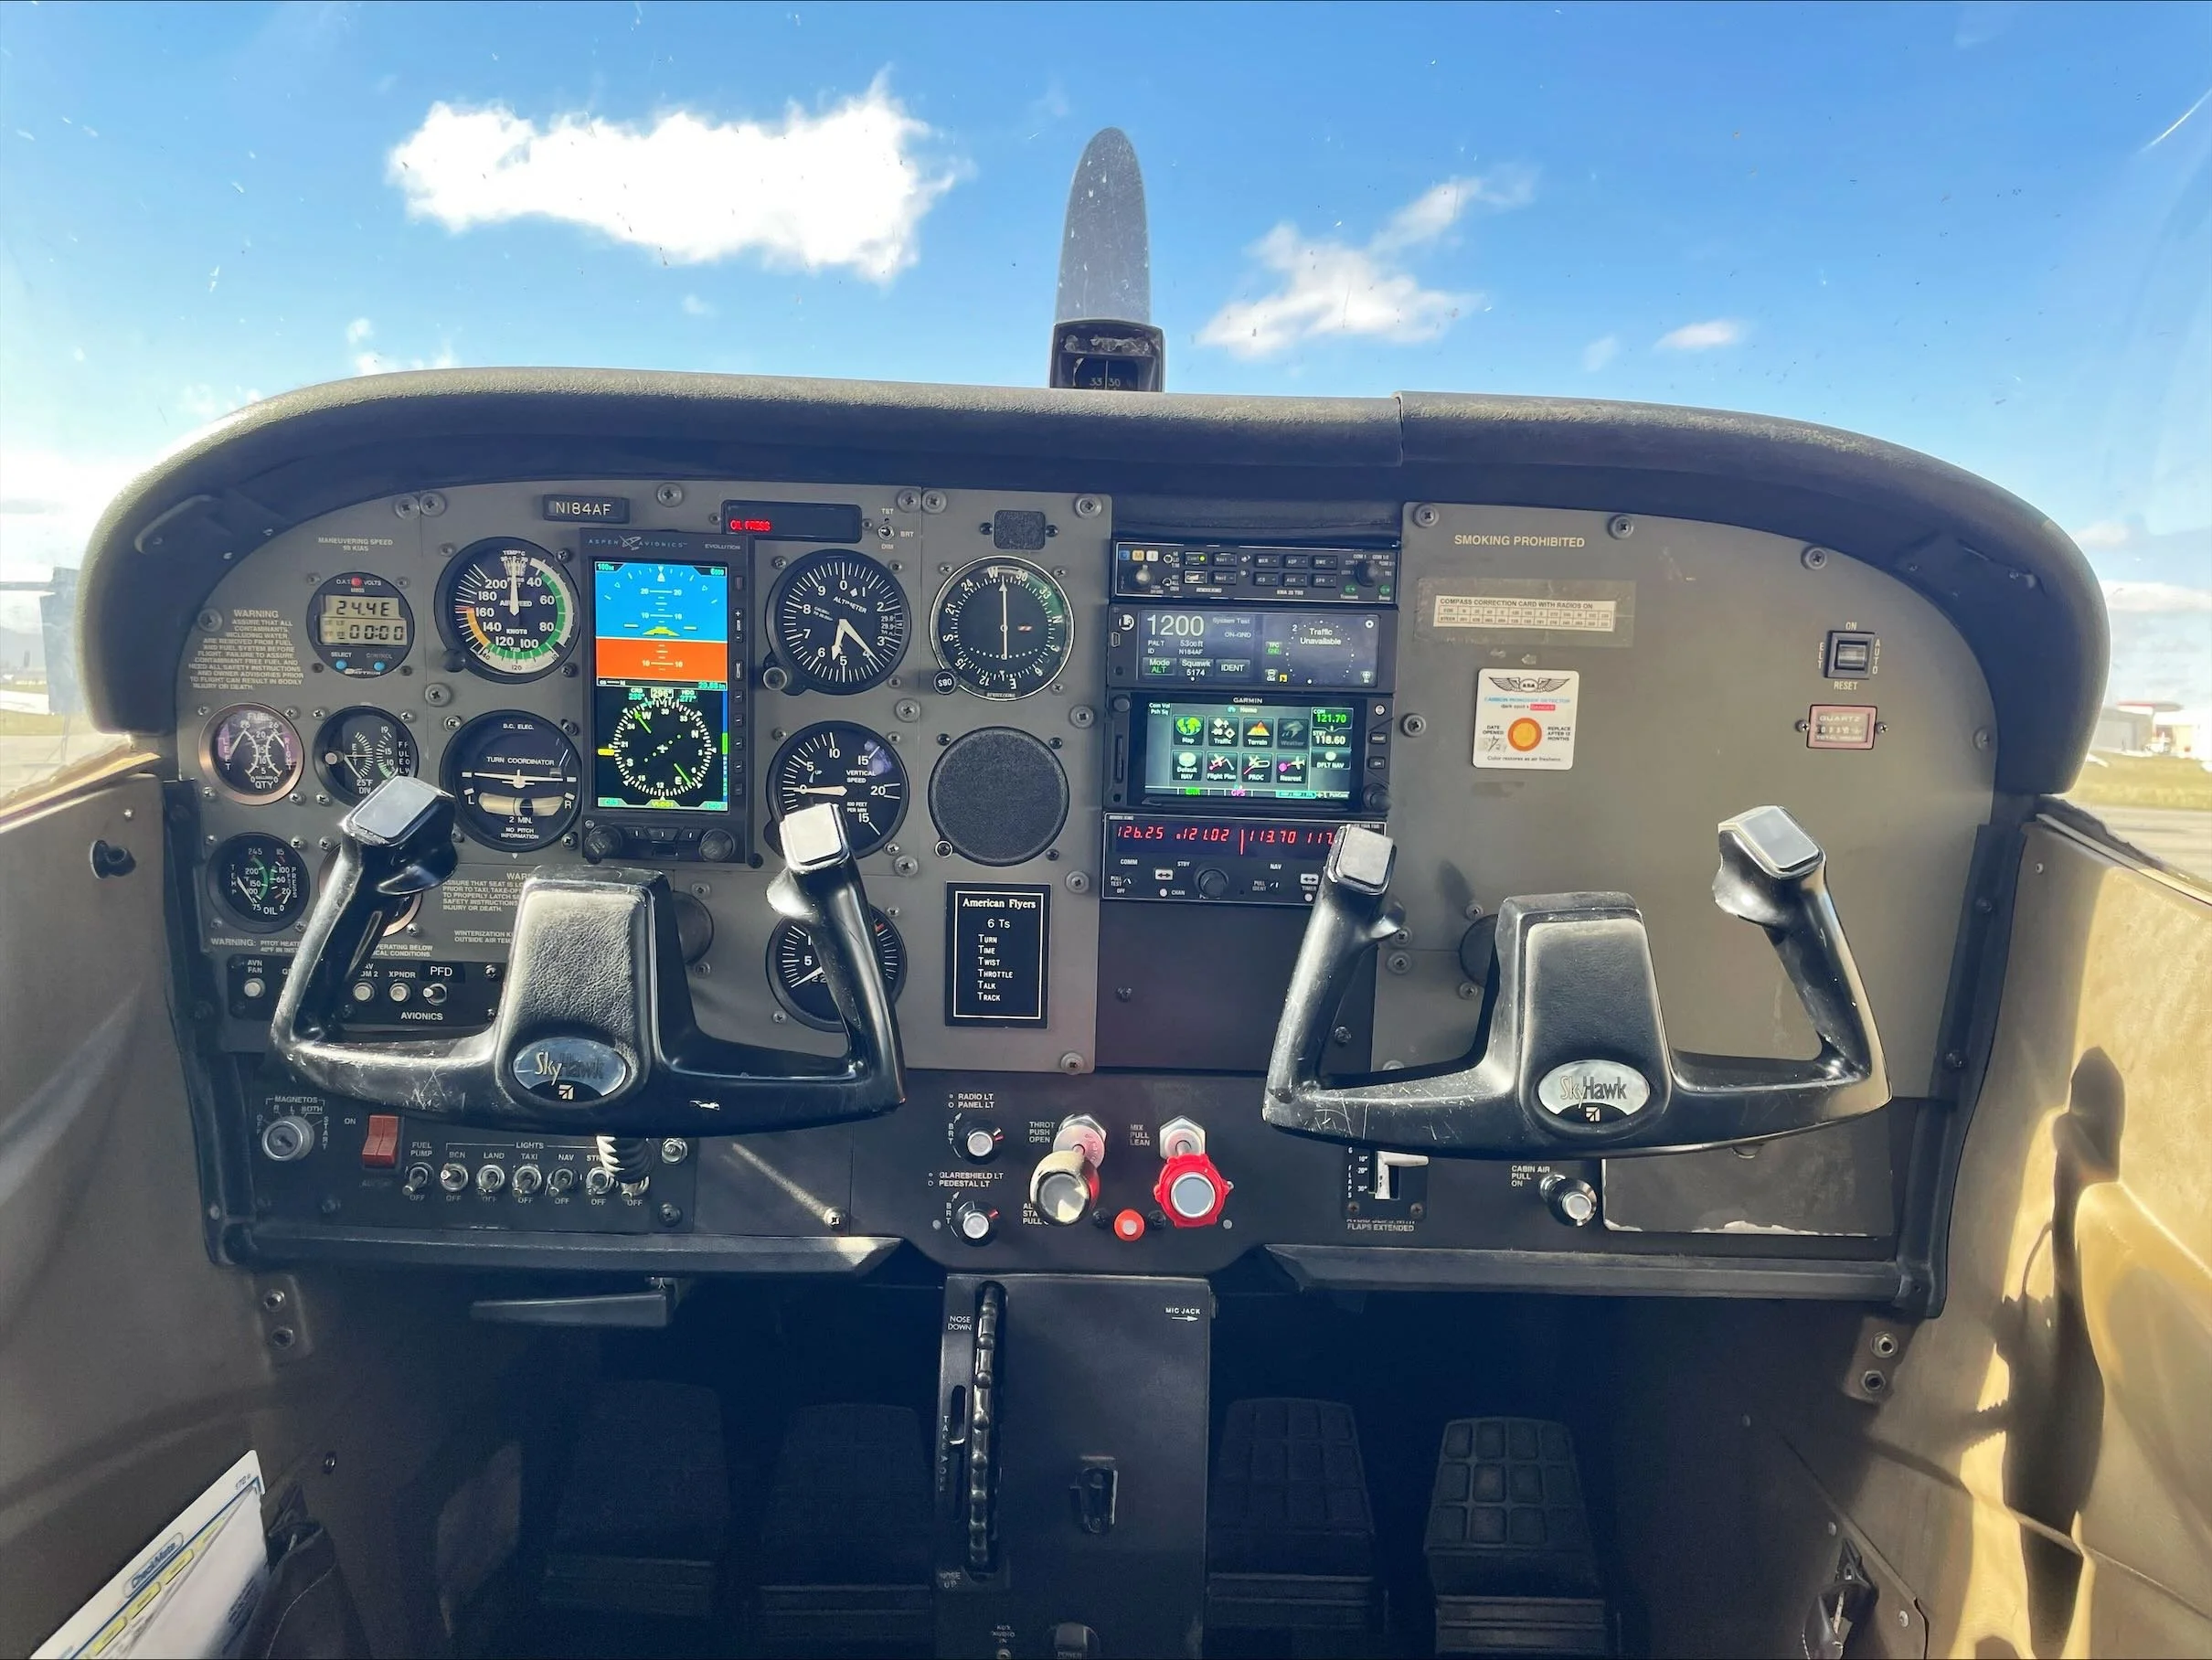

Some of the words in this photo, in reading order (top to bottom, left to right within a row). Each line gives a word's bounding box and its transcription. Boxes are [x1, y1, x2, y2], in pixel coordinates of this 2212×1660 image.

[318, 537, 368, 546] MANEUVERING
[1454, 534, 1510, 547] SMOKING
[1514, 536, 1585, 548] PROHIBITED
[484, 579, 507, 589] 200
[526, 577, 542, 587] 40
[478, 591, 497, 601] 180
[539, 594, 555, 604] 60
[233, 609, 279, 619] WARNING
[475, 607, 495, 617] 160
[483, 622, 502, 632] 140
[538, 622, 554, 632] 80
[1146, 613, 1205, 637] 1200
[1845, 622, 1857, 631] ON
[1309, 627, 1334, 636] Traffic
[495, 636, 514, 646] 120
[520, 639, 539, 649] 100
[1300, 637, 1342, 645] Unavailable
[1149, 658, 1170, 666] Mode
[1182, 659, 1211, 668] Squawk
[1220, 664, 1246, 672] IDENT
[1834, 681, 1858, 690] RESET
[1317, 714, 1347, 723] 121.70
[1315, 735, 1346, 745] 118.60
[828, 749, 840, 759] 10
[507, 757, 555, 766] COORDINATOR
[857, 755, 869, 766] 15
[255, 781, 274, 789] QTY
[870, 786, 887, 796] 20
[858, 813, 869, 823] 15
[962, 899, 1005, 909] American
[1009, 899, 1037, 910] Flyers
[263, 906, 278, 915] OIL
[987, 918, 994, 929] 6
[210, 938, 256, 946] WARNING:
[978, 933, 998, 944] TURN
[978, 944, 995, 954] TIME
[977, 956, 1001, 966] TWIST
[430, 966, 453, 977] PFD
[977, 968, 1014, 978] THROTTLE
[977, 980, 996, 990] TALK
[977, 991, 1001, 1002] TRACK
[400, 1012, 443, 1021] AVIONICS
[1559, 1076, 1627, 1110] SkyHawk
[274, 1095, 318, 1103] MAGNETOS
[410, 1149, 432, 1157] PUMP
[1373, 1224, 1415, 1232] EXTENDED
[947, 1323, 973, 1331] DOWN
